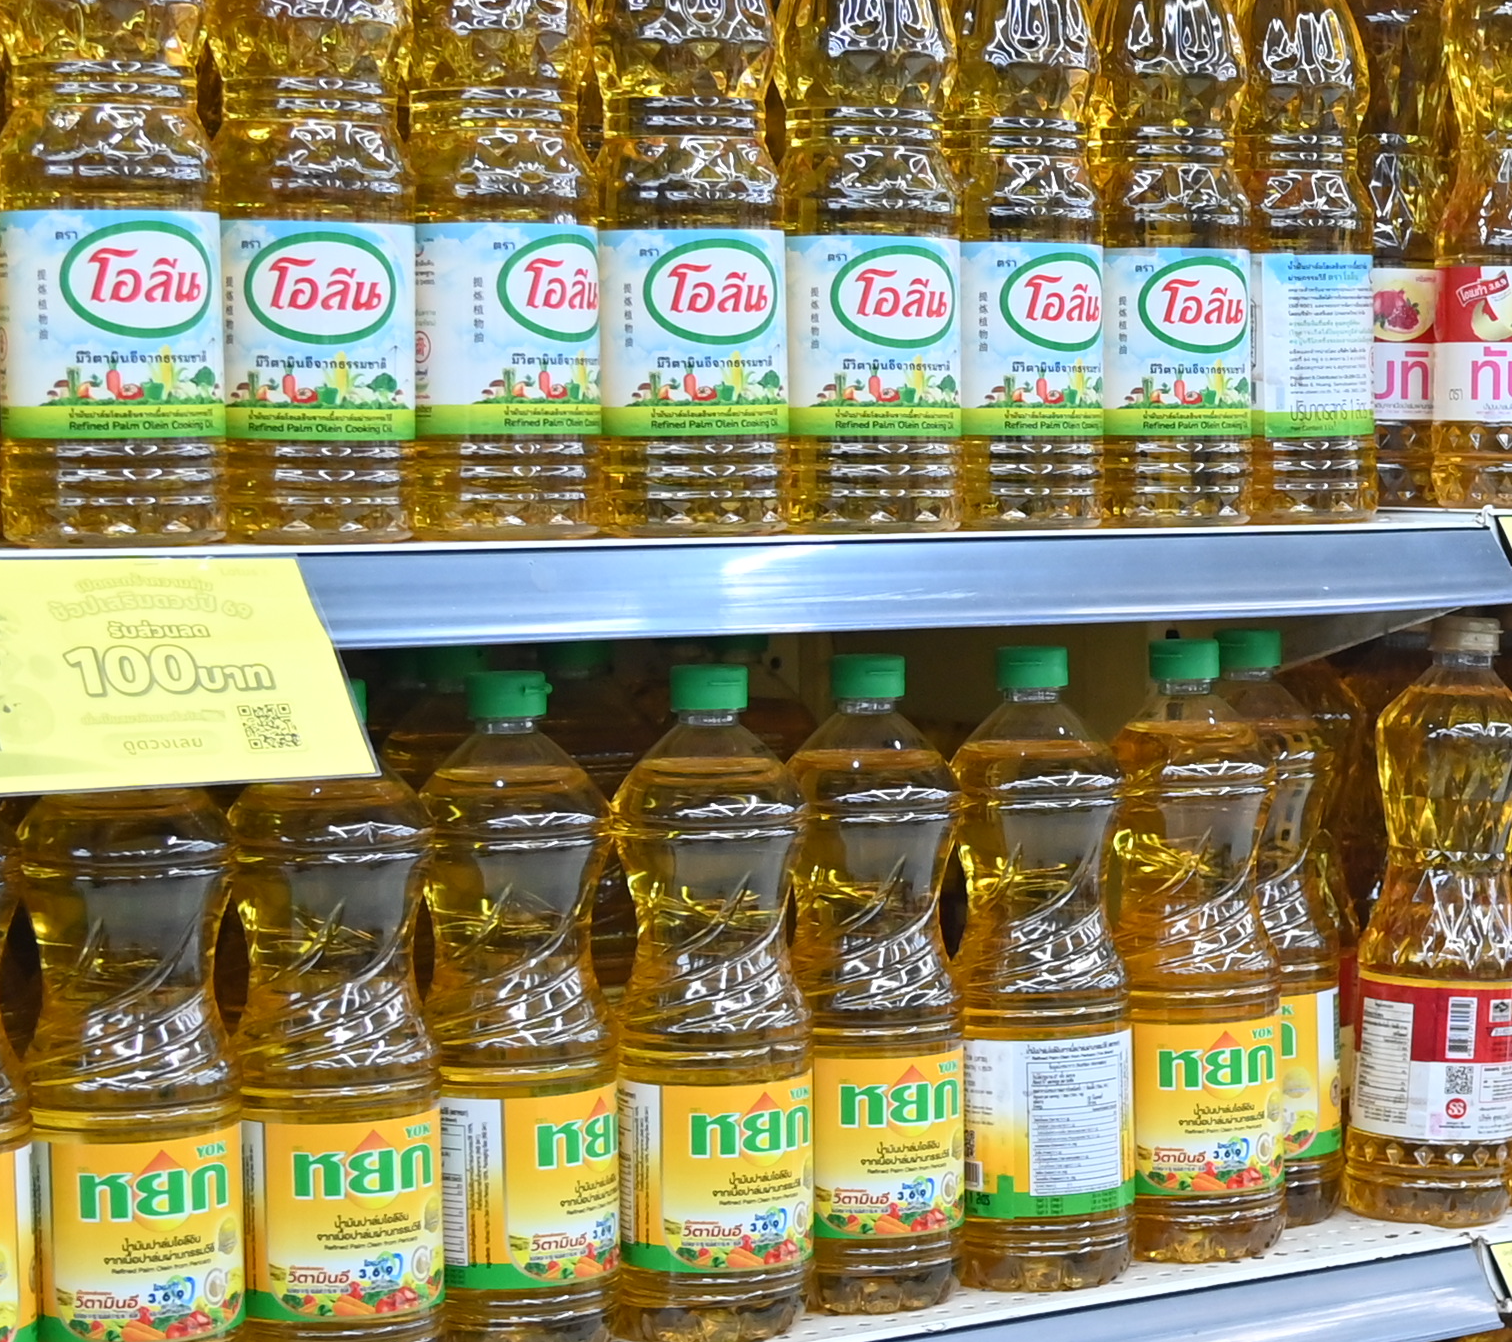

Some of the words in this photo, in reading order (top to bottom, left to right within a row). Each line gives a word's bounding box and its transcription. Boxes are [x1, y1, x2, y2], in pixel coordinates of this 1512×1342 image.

[90, 248, 201, 302] โอลีน
[270, 257, 381, 310] โอลีน
[670, 264, 767, 312] โอลีน
[857, 269, 947, 317] โอลีน
[1163, 279, 1243, 324] โอลีน
[108, 620, 211, 639] รับส่วนลด
[1158, 1044, 1275, 1090] หยก
[841, 1078, 960, 1126] หยก
[196, 1140, 227, 1159] YOK
[538, 1114, 619, 1167] หย
[692, 1107, 807, 1155] หยก
[295, 1145, 430, 1196] หยก
[1153, 1150, 1206, 1164] วิตามินอี
[81, 1165, 226, 1218] หยก
[75, 1294, 139, 1310] วิตามินอี
